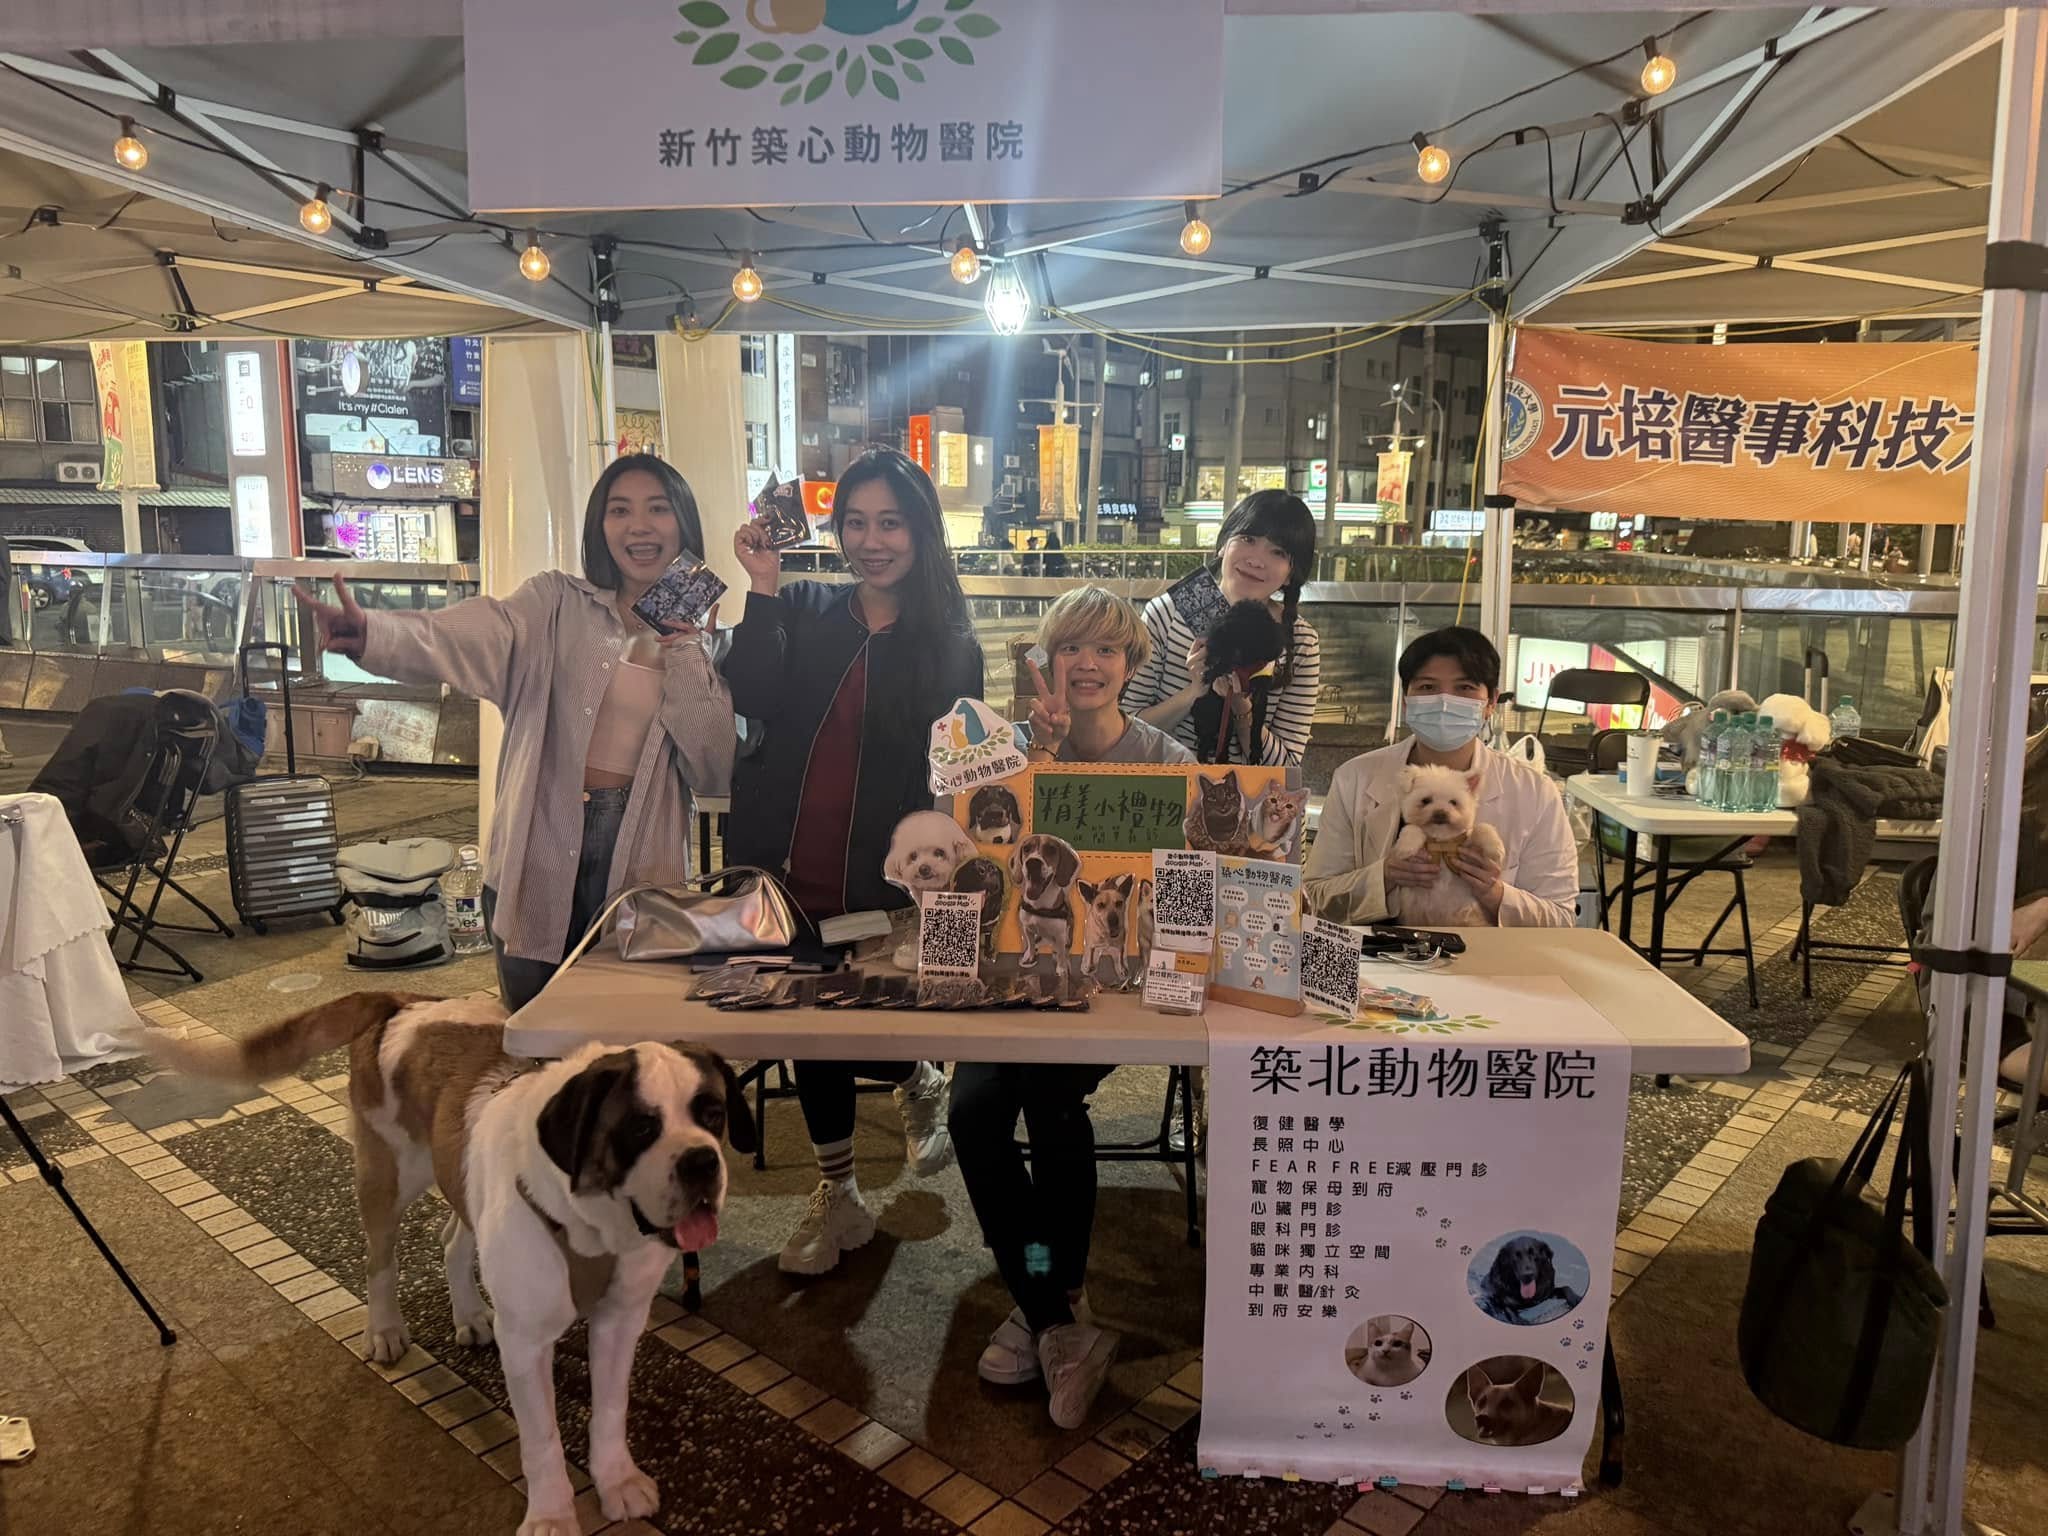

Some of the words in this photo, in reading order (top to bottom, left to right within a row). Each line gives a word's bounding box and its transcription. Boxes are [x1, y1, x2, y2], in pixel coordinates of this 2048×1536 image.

[658, 119, 1025, 168] 新竹築心動物醫院
[392, 465, 444, 485] LENS
[1037, 782, 1183, 830] 精美小禮物
[1250, 1045, 1596, 1100] 築北動物醫院
[1253, 1115, 1346, 1133] 復健醫學
[1252, 1136, 1345, 1154] 長照中心
[1252, 1159, 1317, 1174] FEAR
[1251, 1180, 1393, 1198] 寵物保母到府
[1251, 1201, 1342, 1217] 心臟門診
[1250, 1221, 1342, 1238] 眼科門診
[1250, 1243, 1391, 1260] 貓咪獨立空間
[1249, 1263, 1340, 1279] 專業內科
[1247, 1303, 1338, 1319] 到府安樂
